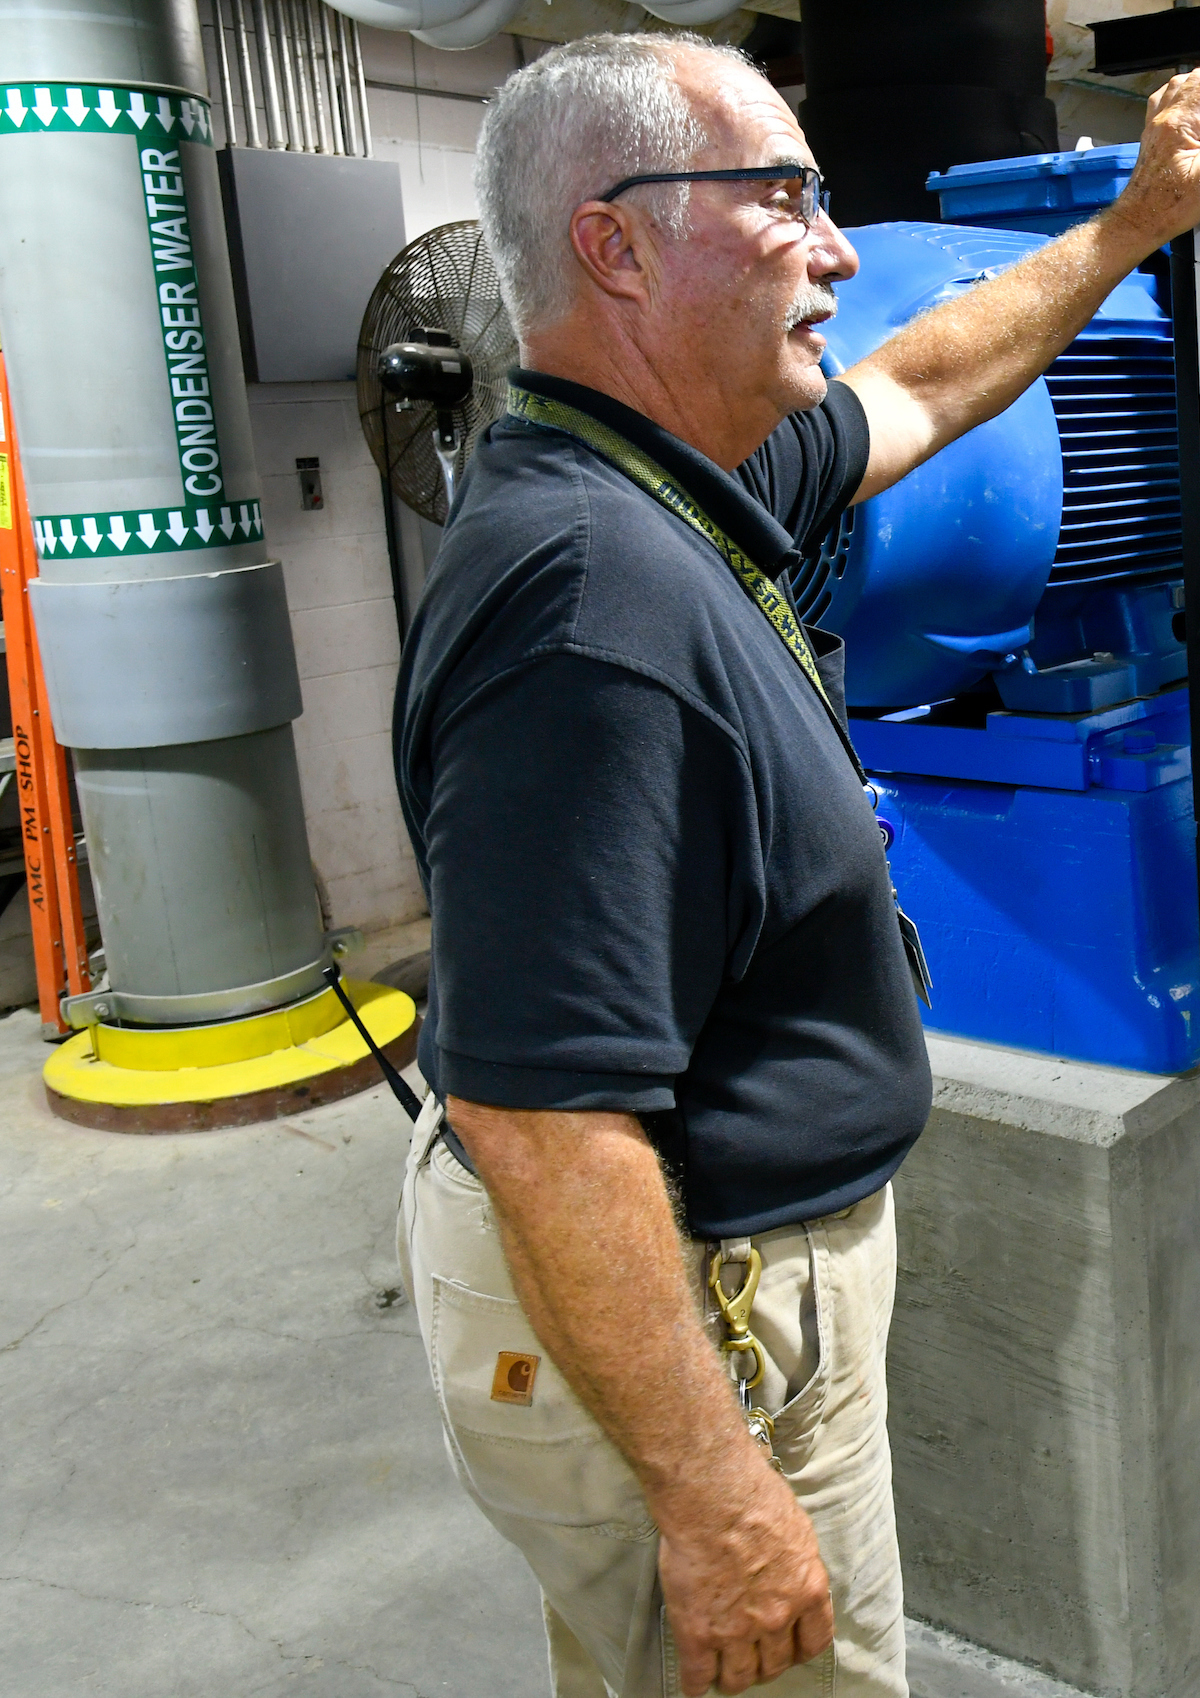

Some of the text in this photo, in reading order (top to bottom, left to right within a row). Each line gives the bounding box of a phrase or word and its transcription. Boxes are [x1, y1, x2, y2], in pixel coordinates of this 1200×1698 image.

[141, 148, 222, 496] CONDENSER WATER
[16, 725, 45, 912] AMC PM SHOP
[740, 1309, 746, 1318] 2
